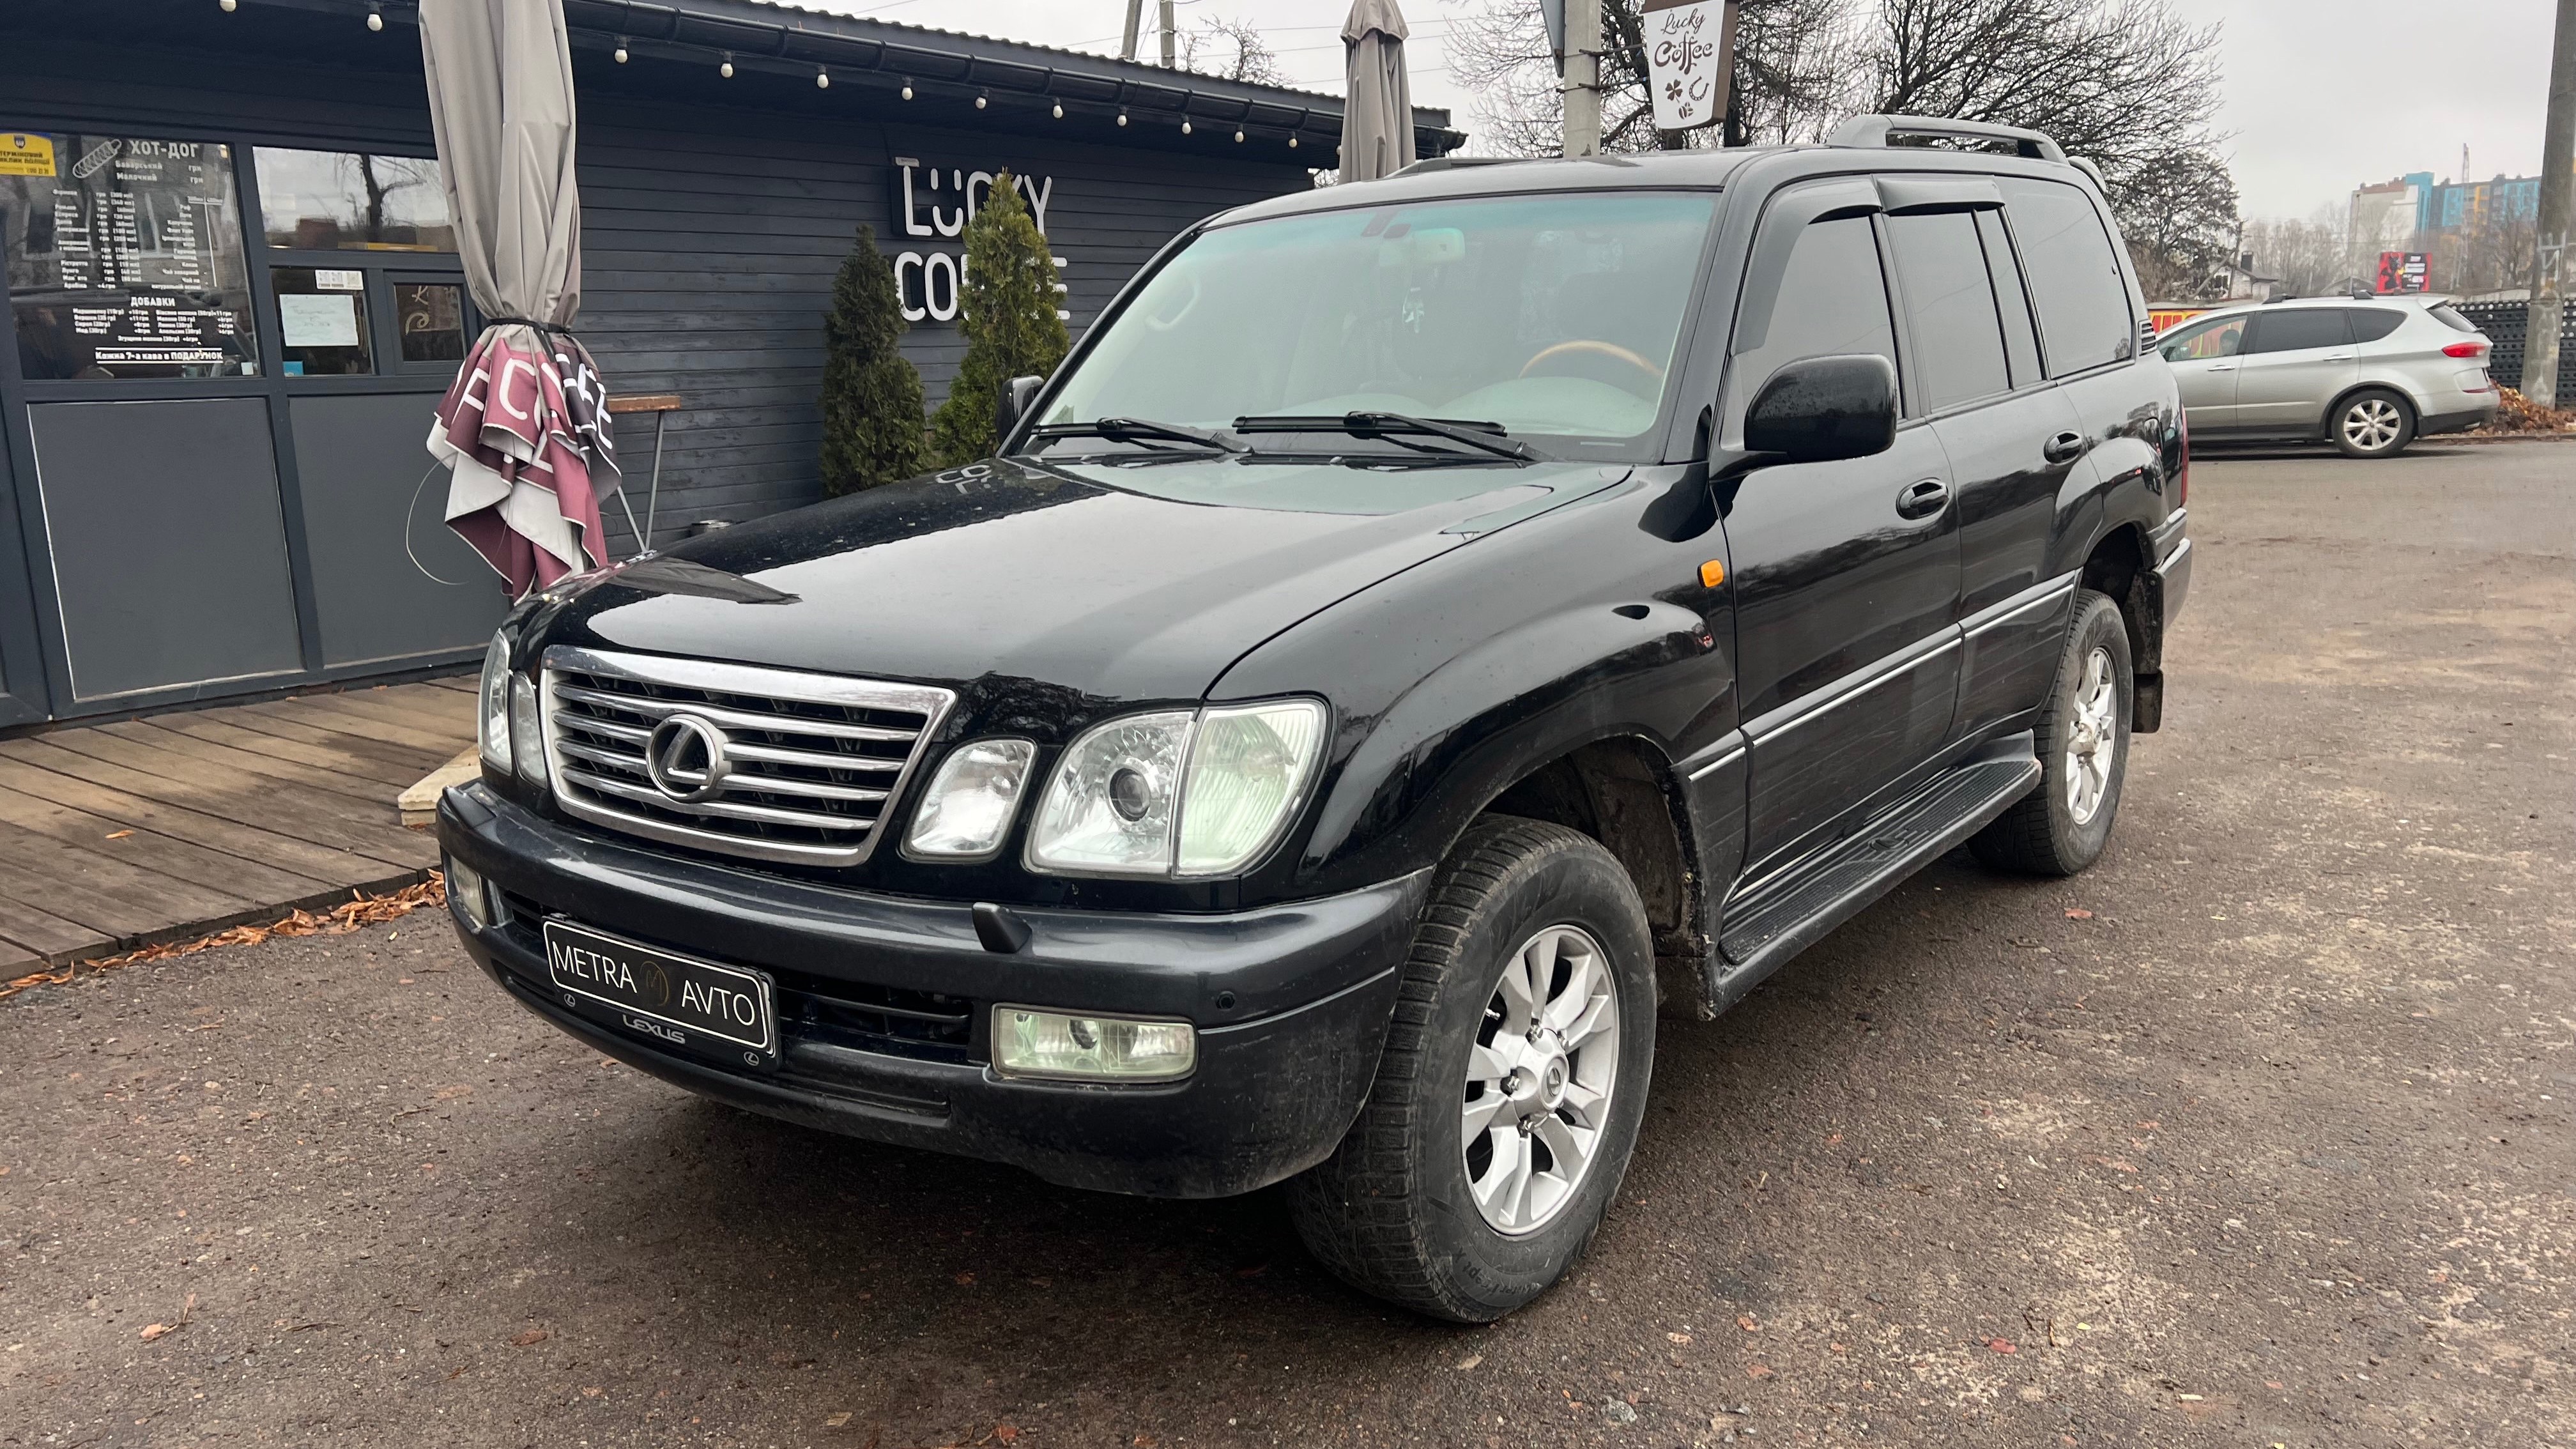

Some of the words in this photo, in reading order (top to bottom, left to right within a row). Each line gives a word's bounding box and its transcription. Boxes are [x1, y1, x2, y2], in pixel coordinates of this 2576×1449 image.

[1660, 8, 1705, 34] Lucky
[1654, 31, 1712, 75] Coffee
[128, 139, 199, 159] ХОТ-ДОГ
[130, 296, 176, 307] ДОБАВКИ
[95, 351, 125, 360] Кожна
[171, 351, 224, 361] ПОДАРУНОК
[552, 940, 638, 993] METRA
[681, 979, 755, 1026] AVTO
[622, 1014, 686, 1045] LEXUS
